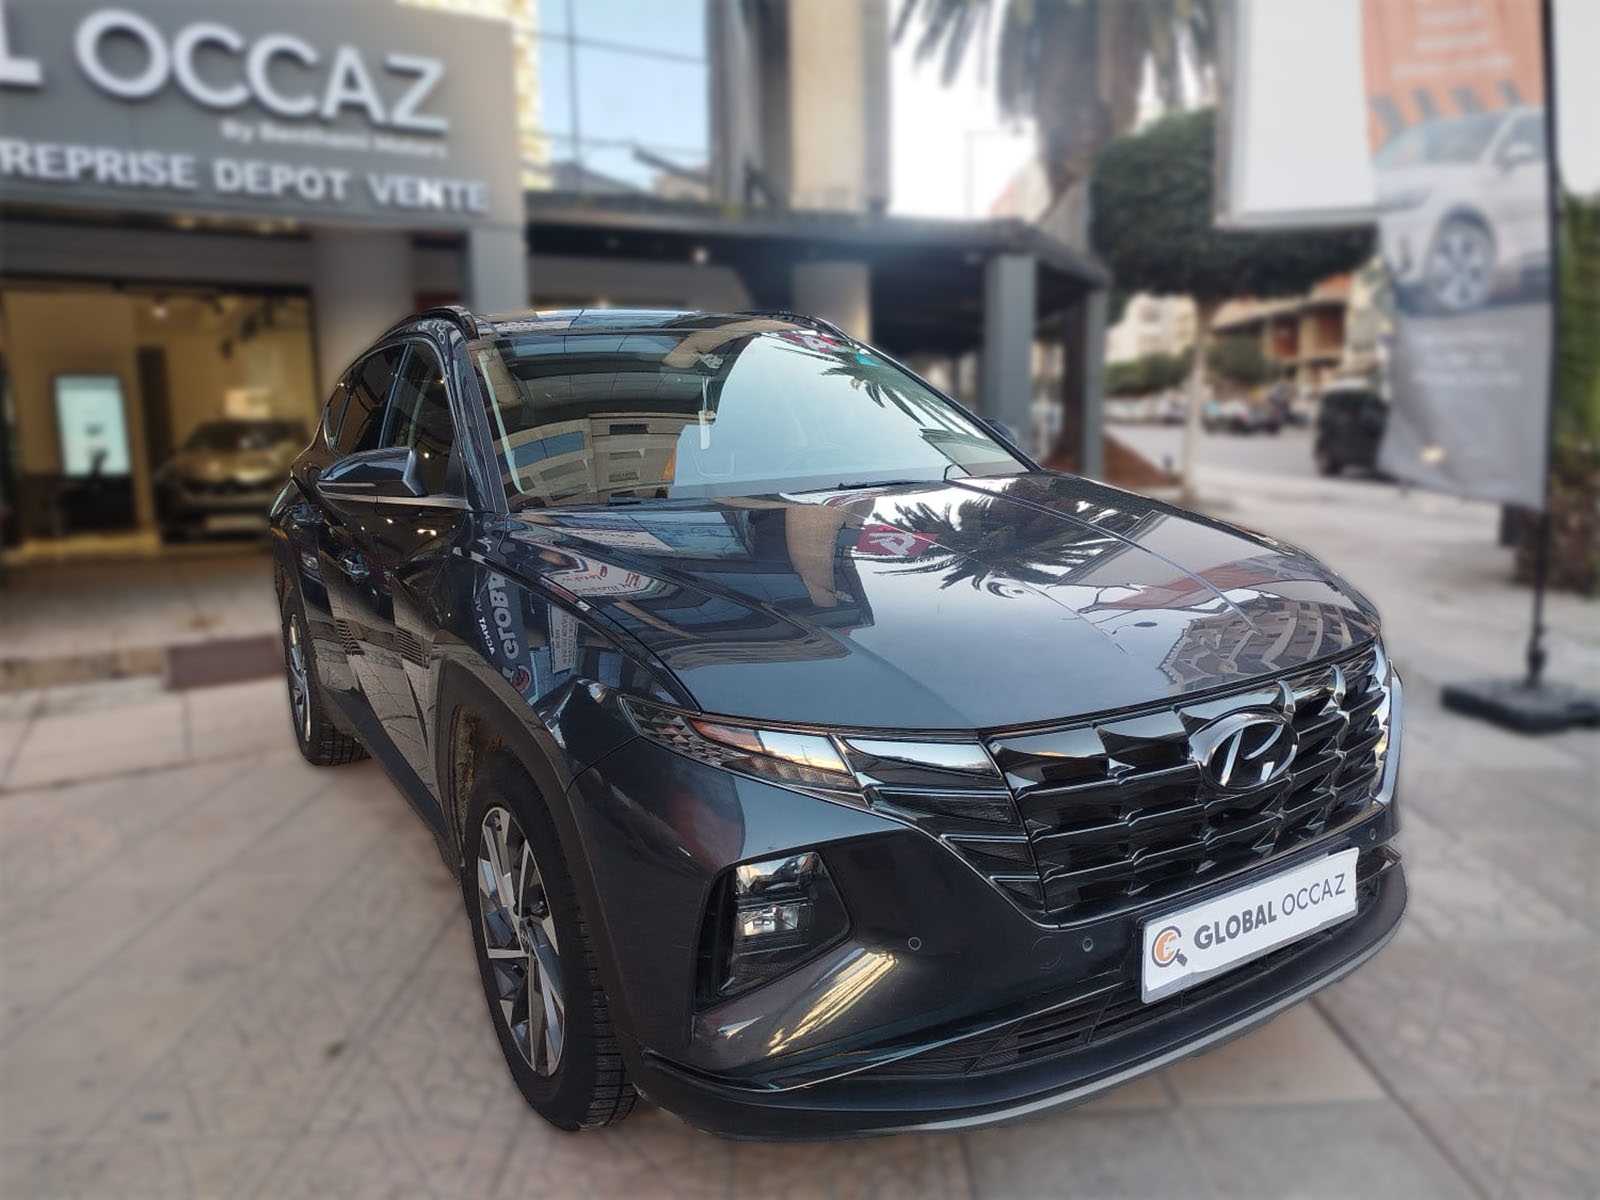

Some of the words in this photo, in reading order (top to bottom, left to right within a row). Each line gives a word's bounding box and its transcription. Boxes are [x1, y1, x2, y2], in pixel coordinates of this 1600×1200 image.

[75, 9, 448, 131] OCCAZ
[0, 138, 197, 188] REPRISE
[213, 158, 349, 200] DEPOT
[367, 172, 488, 212] VENTE
[1194, 900, 1278, 950] GLOBAL
[1281, 872, 1346, 917] OCCAZ
